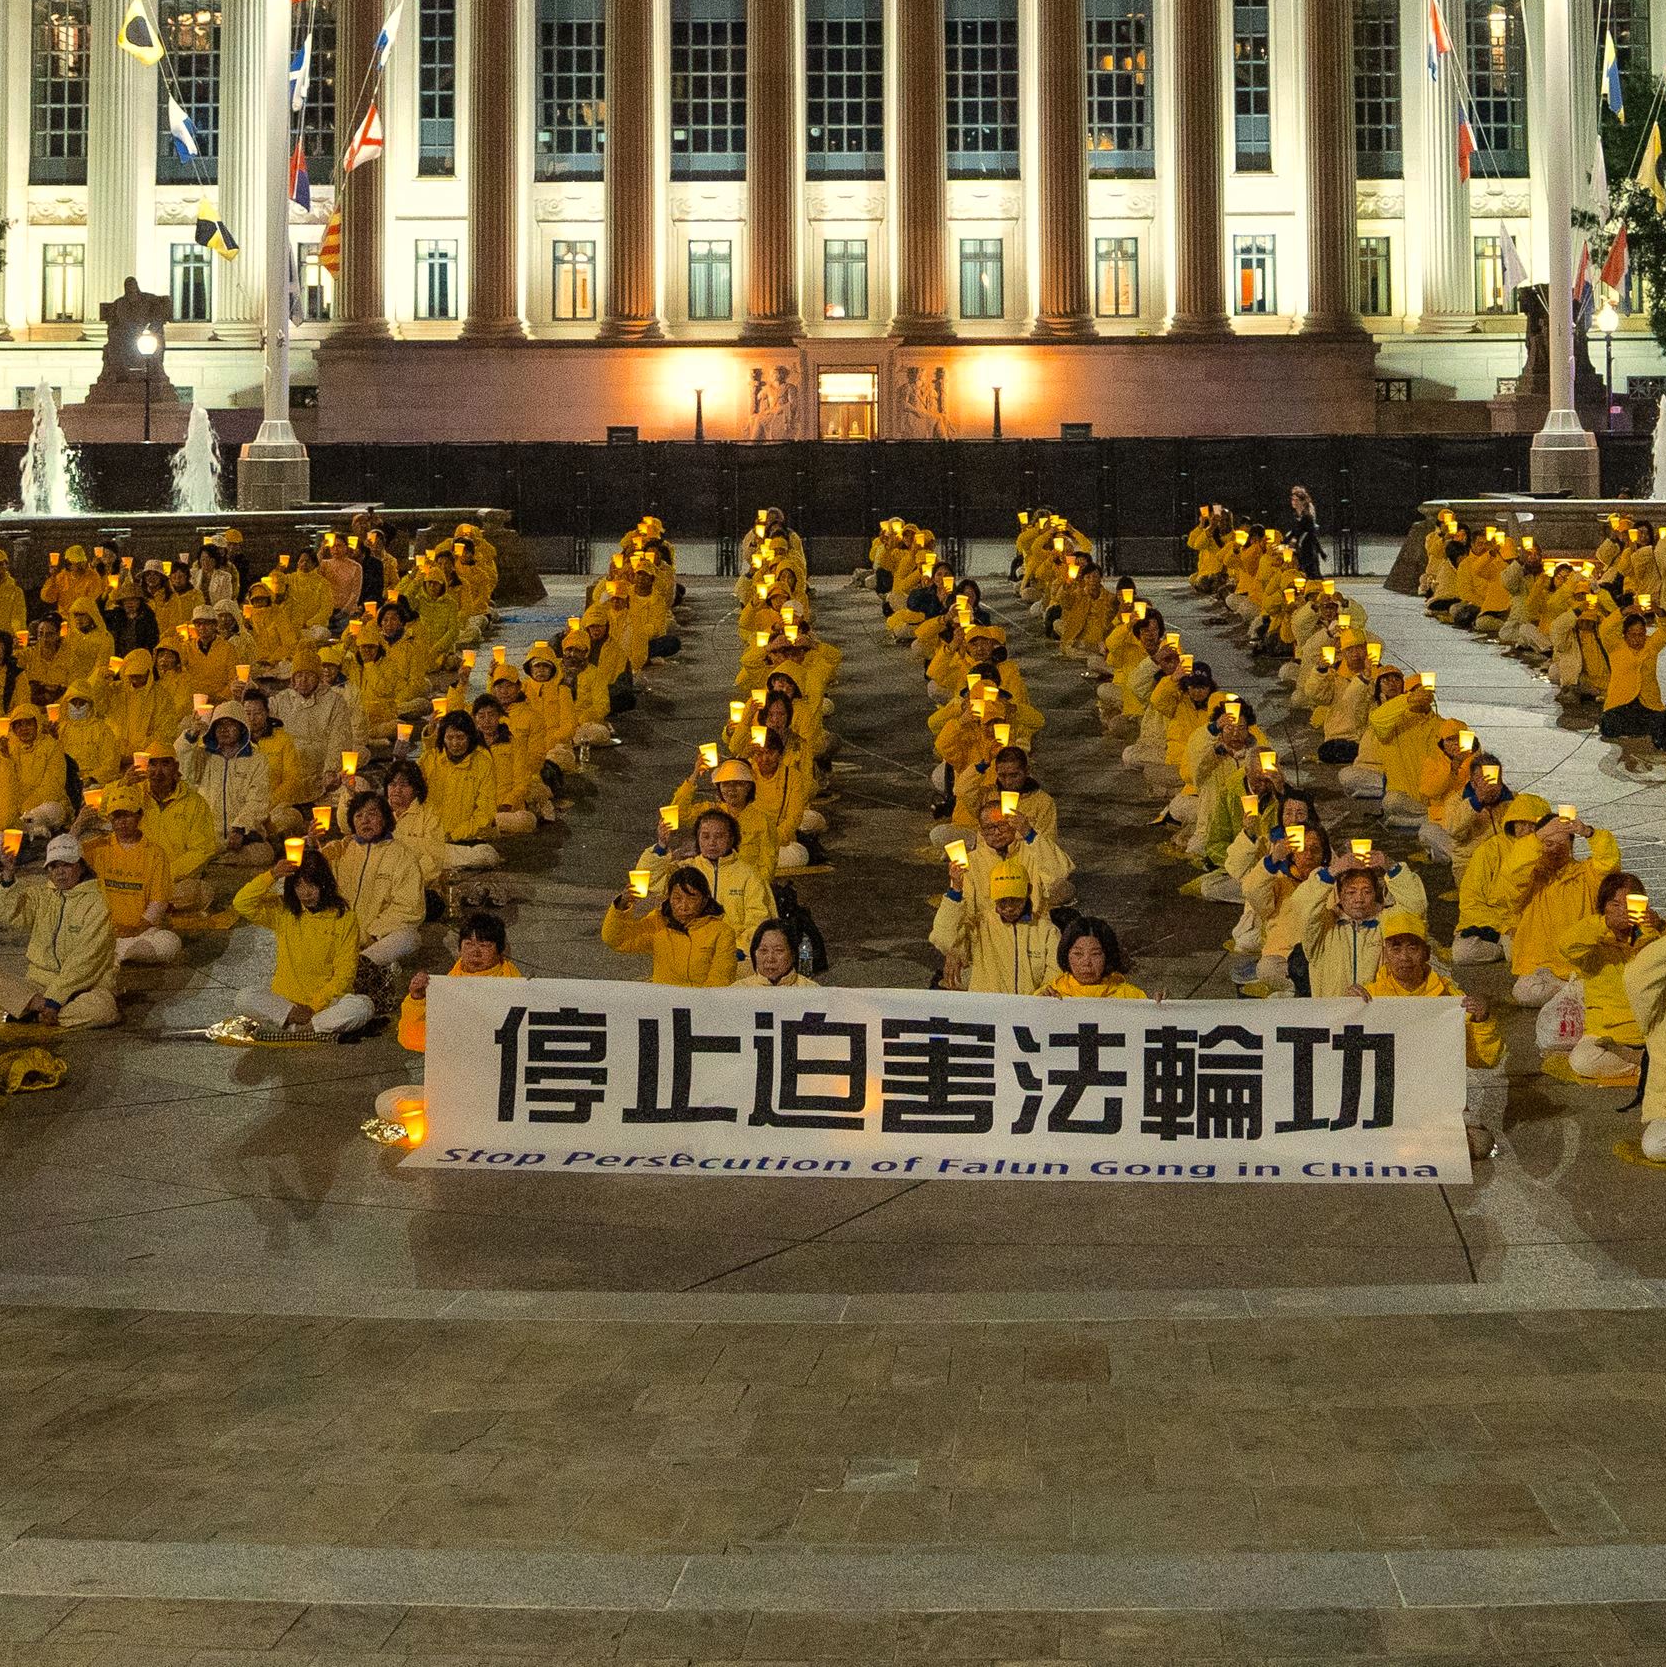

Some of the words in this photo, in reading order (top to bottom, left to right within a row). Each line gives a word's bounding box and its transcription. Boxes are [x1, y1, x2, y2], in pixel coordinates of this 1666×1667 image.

[493, 1006, 1397, 1142] 停止迫害法輪功
[436, 1147, 546, 1167] Stop
[561, 1150, 853, 1174] Persecution
[870, 1156, 923, 1173] of
[937, 1158, 1070, 1176] Falun
[1089, 1160, 1218, 1179] Gong
[1237, 1161, 1282, 1177] in
[1301, 1160, 1440, 1178] China
